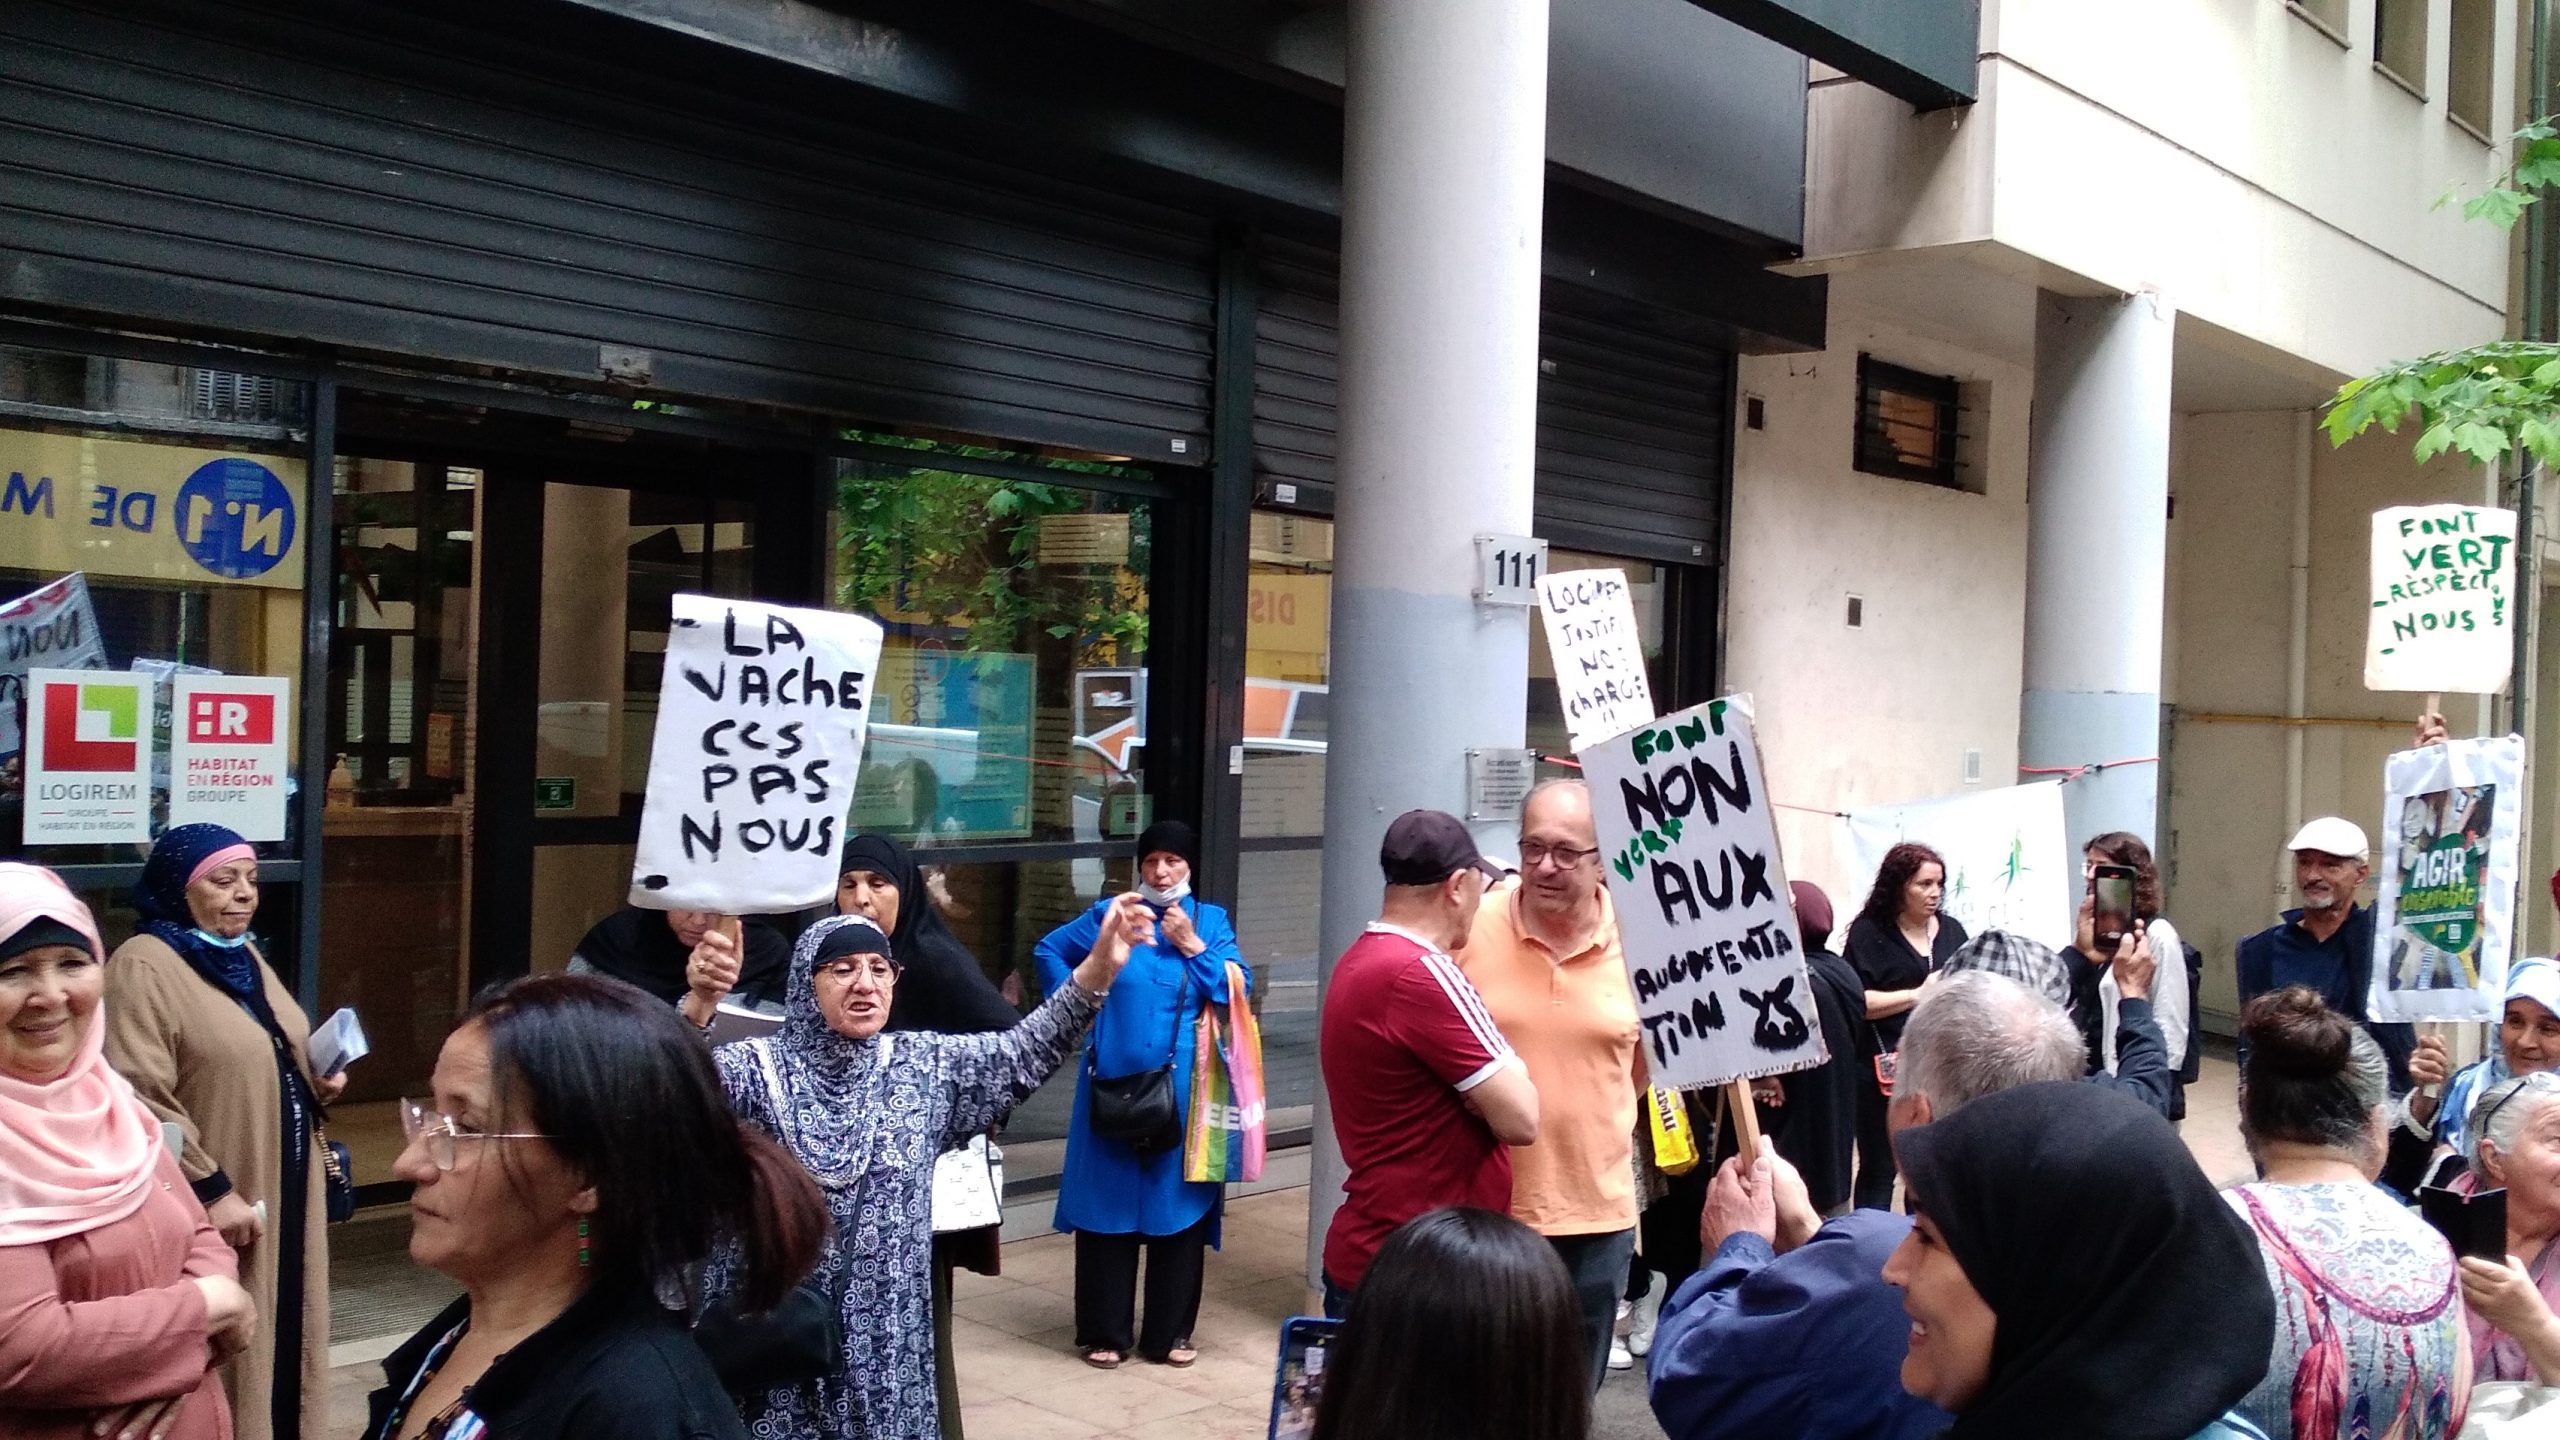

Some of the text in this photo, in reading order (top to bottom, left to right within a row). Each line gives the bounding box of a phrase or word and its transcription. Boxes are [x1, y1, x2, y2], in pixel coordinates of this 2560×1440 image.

[2399, 511, 2480, 537] FONT
[1495, 550, 1537, 589] 111
[2402, 535, 2513, 571] VERT
[724, 607, 805, 657] LA
[2392, 610, 2475, 641] NOUS
[1632, 701, 1728, 765] FONT
[187, 773, 273, 786] EN RÉGION
[188, 759, 258, 771] HABITAT
[703, 760, 830, 805] PAS
[40, 784, 137, 800] LOGIREM
[187, 791, 247, 802] GROUPE
[1620, 741, 1752, 832] NON
[681, 809, 834, 863] NOUS
[1650, 843, 1775, 926] AUX
[2412, 847, 2466, 888] AGIR
